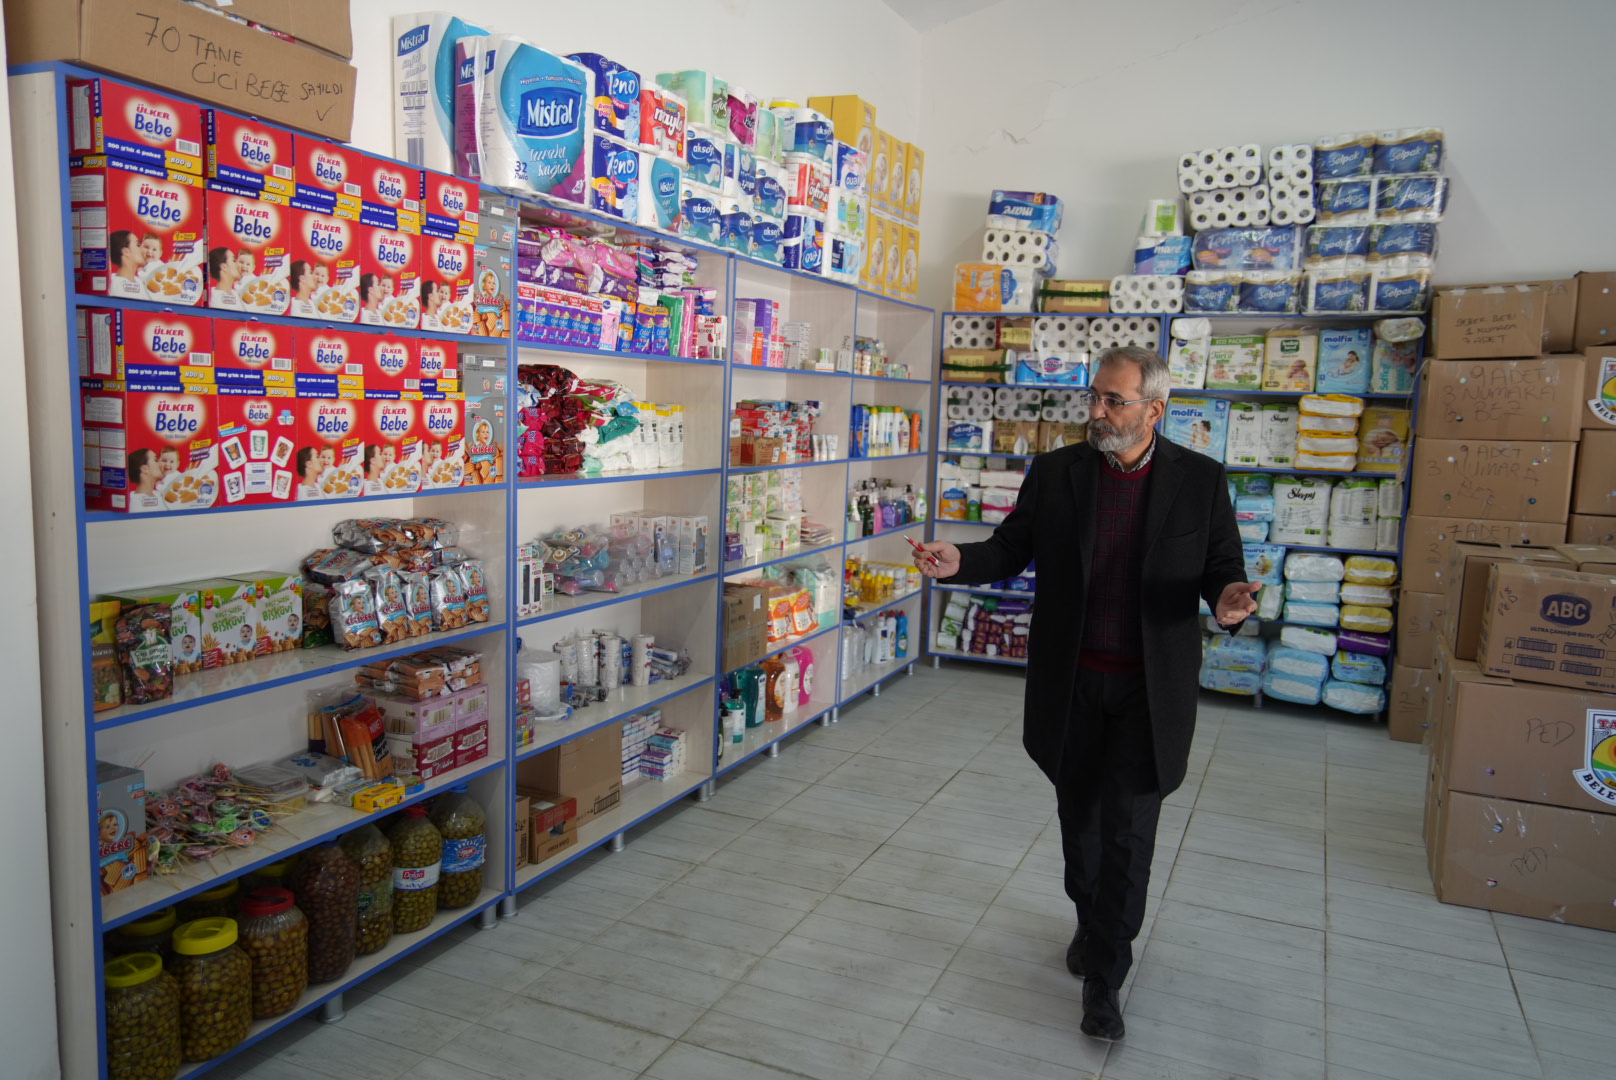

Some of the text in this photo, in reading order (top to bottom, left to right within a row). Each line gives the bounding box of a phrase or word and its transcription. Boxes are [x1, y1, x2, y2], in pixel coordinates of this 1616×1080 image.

[136, 12, 243, 66] 70 TANE
[400, 30, 426, 51] Mistral
[607, 69, 636, 96] Teno
[136, 103, 171, 121] ÜLKER
[528, 97, 573, 128] Mistral
[134, 113, 173, 138] Bebe
[243, 133, 270, 148] ÜLKER
[107, 142, 120, 150] 200
[136, 146, 141, 154] 4
[142, 148, 162, 160] paket
[170, 157, 185, 166] 800
[186, 161, 192, 169] g
[241, 142, 271, 164] Bebe
[529, 144, 568, 163] Tuvalet
[693, 142, 714, 156] aksoft
[1391, 148, 1421, 160] Selpak
[318, 154, 341, 168] ÜLKER
[607, 151, 636, 176] Teno
[1332, 150, 1360, 166] Selpak
[112, 160, 124, 168] 200
[144, 166, 164, 177] paket
[173, 174, 188, 182] 800
[188, 176, 194, 186] g
[316, 162, 342, 183] Bebe
[514, 161, 528, 173] 32
[537, 161, 572, 180] Kağıdı
[380, 172, 400, 184] ÜLKER
[140, 183, 179, 201] ÜLKER
[378, 181, 402, 198] Bebe
[444, 187, 463, 198] ÜLKER
[137, 195, 182, 223] Bebe
[442, 194, 464, 211] Bebe
[692, 202, 716, 215] aksoft
[235, 204, 270, 220] ÜLKER
[1003, 206, 1034, 216] mare
[234, 214, 272, 239] Bebe
[312, 220, 342, 234] ÜLKER
[310, 230, 343, 252] Bebe
[380, 235, 405, 248] ÜLKER
[378, 245, 406, 264] Bebe
[439, 244, 461, 256] ÜLKER
[1154, 246, 1183, 254] mare
[438, 254, 462, 272] Bebe
[1260, 288, 1286, 299] Selpak
[1383, 287, 1413, 298] Selpak
[154, 326, 184, 336] ÜLKER
[240, 331, 268, 343] ÜLKER
[152, 336, 186, 354] Bebe
[318, 341, 342, 350] ÜLKER
[1474, 334, 1506, 344] ADET
[239, 342, 270, 359] Bebe
[316, 350, 343, 364] Bebe
[382, 346, 402, 354] ÜLKER
[422, 348, 440, 357] ÜLKER
[380, 354, 404, 368] Bebe
[421, 357, 442, 370] Bebe
[199, 372, 204, 380] g
[1470, 365, 1546, 388] 9 ADET
[189, 384, 203, 392] 800
[204, 386, 209, 394] g
[1463, 386, 1555, 401] NUMARA
[158, 400, 195, 412] ÜLKER
[319, 406, 347, 415] ÜLKER
[382, 406, 406, 415] ÜLKER
[430, 405, 452, 414] ÜLKER
[1171, 408, 1204, 418] molfix
[155, 413, 198, 432] Bebe
[248, 410, 268, 420] Bebe
[428, 414, 453, 430] Bebe
[317, 416, 349, 433] Bebe
[380, 416, 408, 431] Bebe
[1477, 446, 1521, 459] ADET
[1287, 488, 1316, 500] Sleepy
[1466, 523, 1512, 542] ADET
[1546, 600, 1587, 620] ABC
[1530, 626, 1548, 634] ULTRA
[1526, 718, 1575, 748] PED
